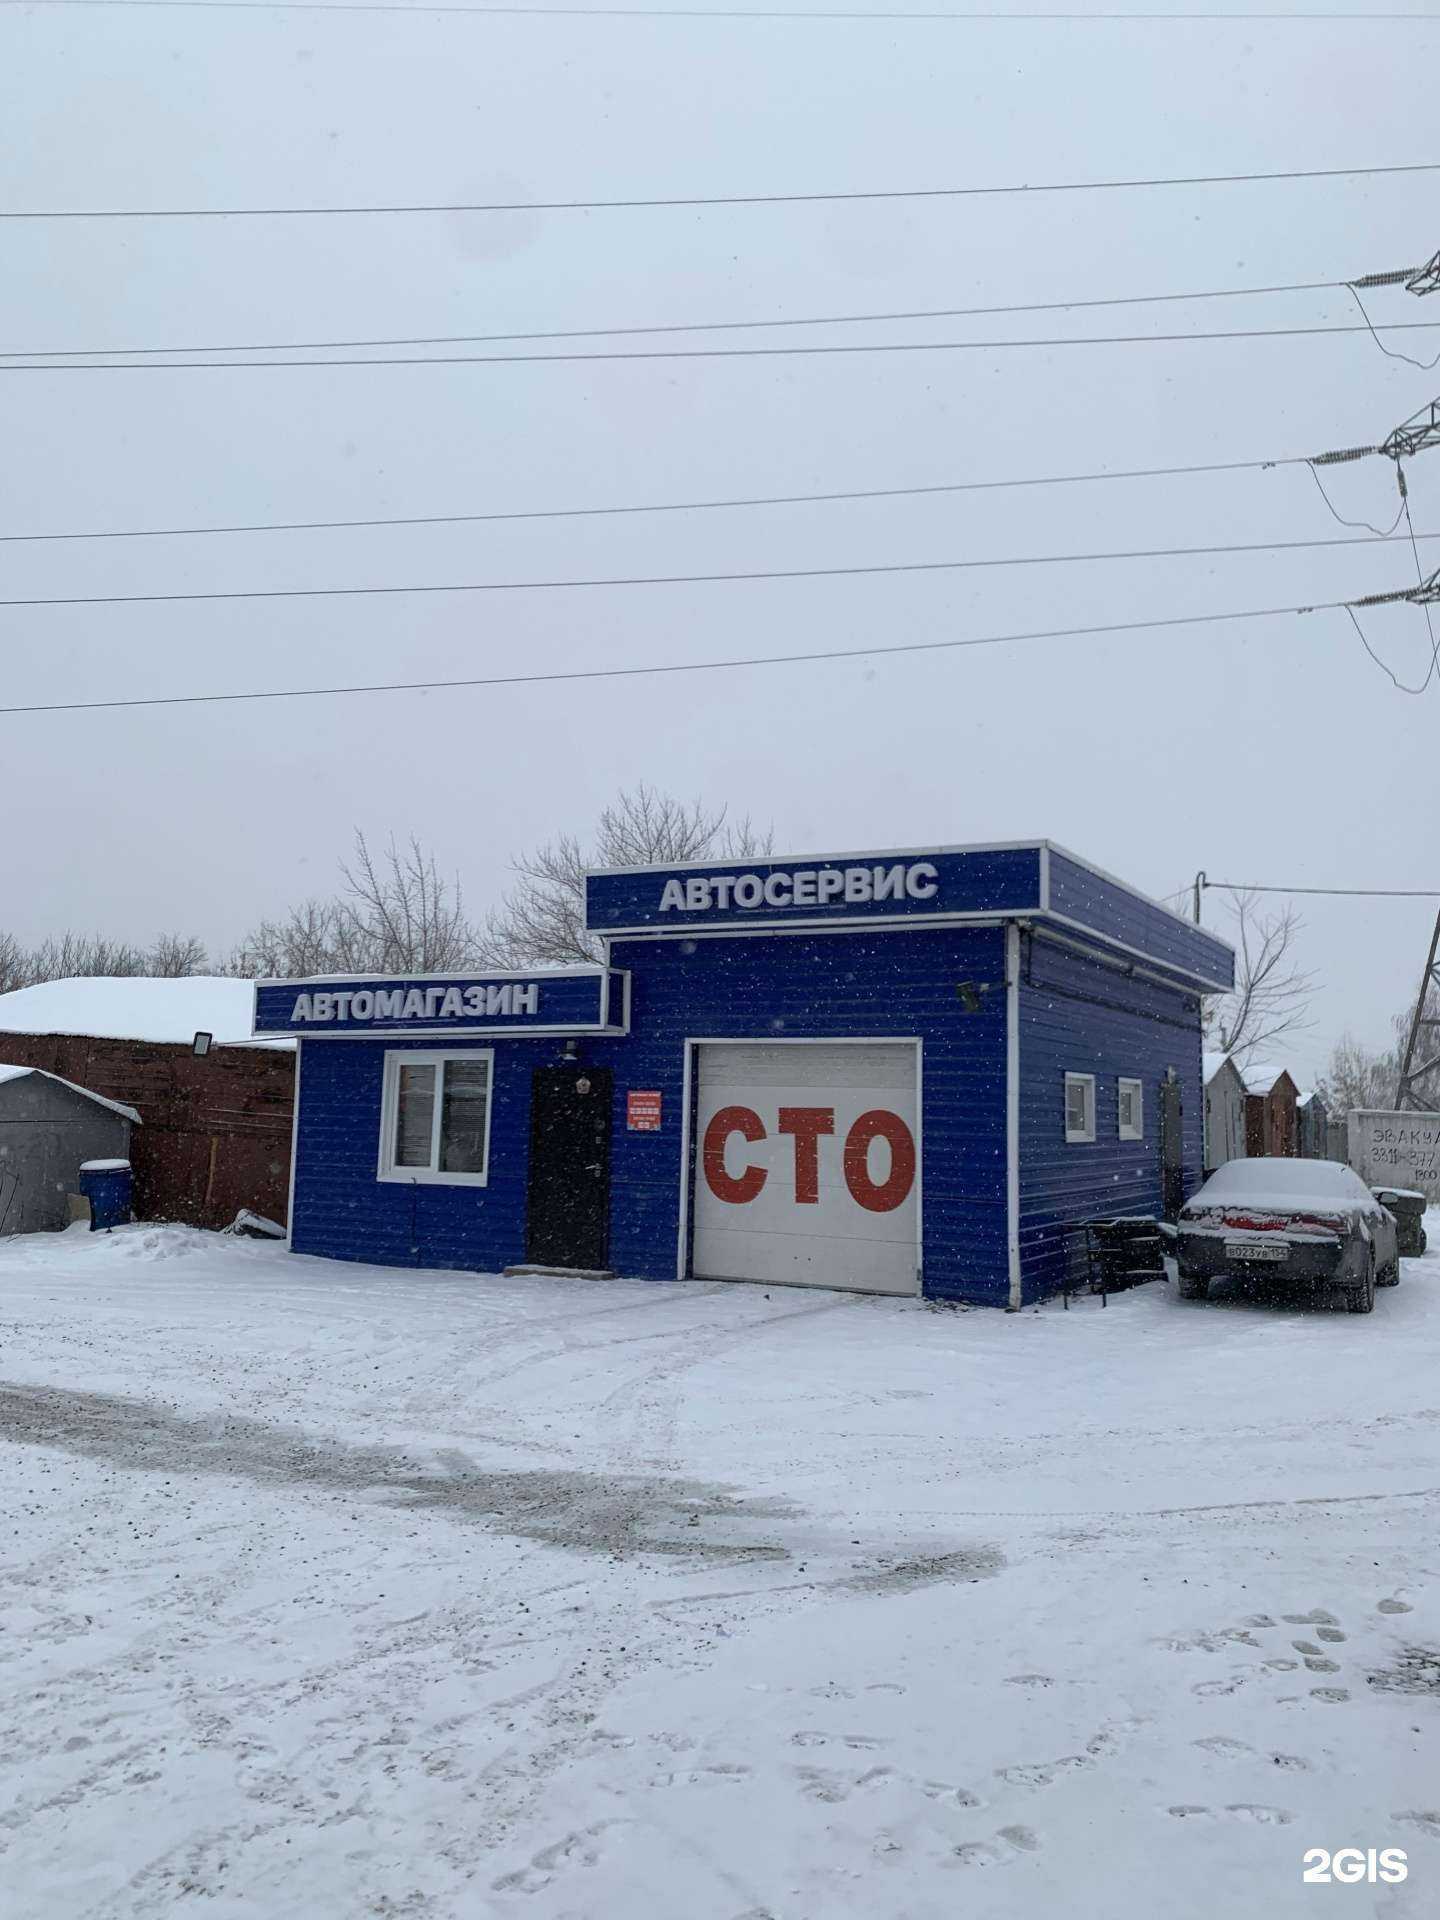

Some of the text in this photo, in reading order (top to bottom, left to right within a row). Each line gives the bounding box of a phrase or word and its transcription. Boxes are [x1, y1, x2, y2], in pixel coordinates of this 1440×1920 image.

[658, 863, 938, 911] АВТОСЕРВИС
[290, 984, 539, 1022] АВТОМАГАЗИН
[703, 1106, 916, 1213] СТО
